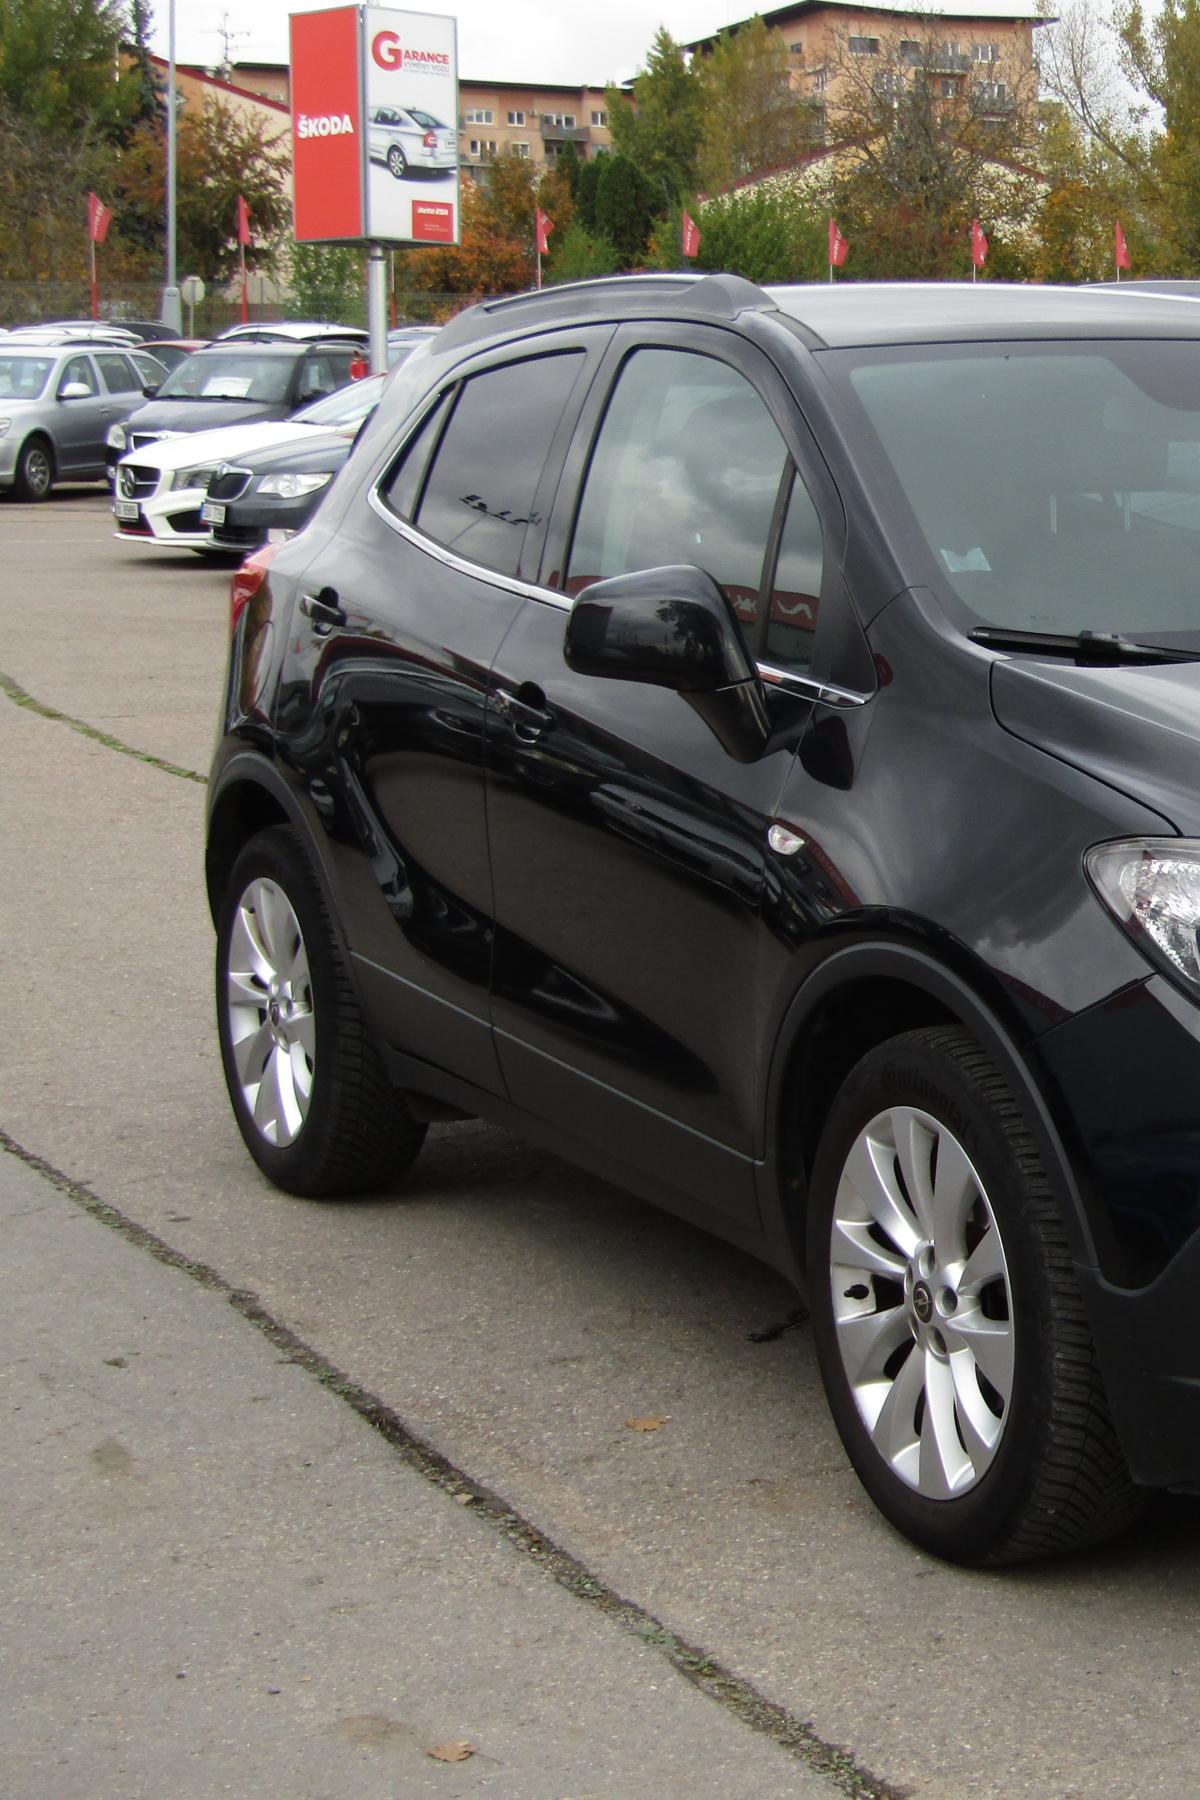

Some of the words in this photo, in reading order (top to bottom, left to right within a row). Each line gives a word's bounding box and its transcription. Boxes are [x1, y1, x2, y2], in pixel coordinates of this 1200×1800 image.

[372, 31, 449, 71] GARANCE
[298, 114, 354, 138] ŠKODA
[881, 1061, 971, 1137] Continental
